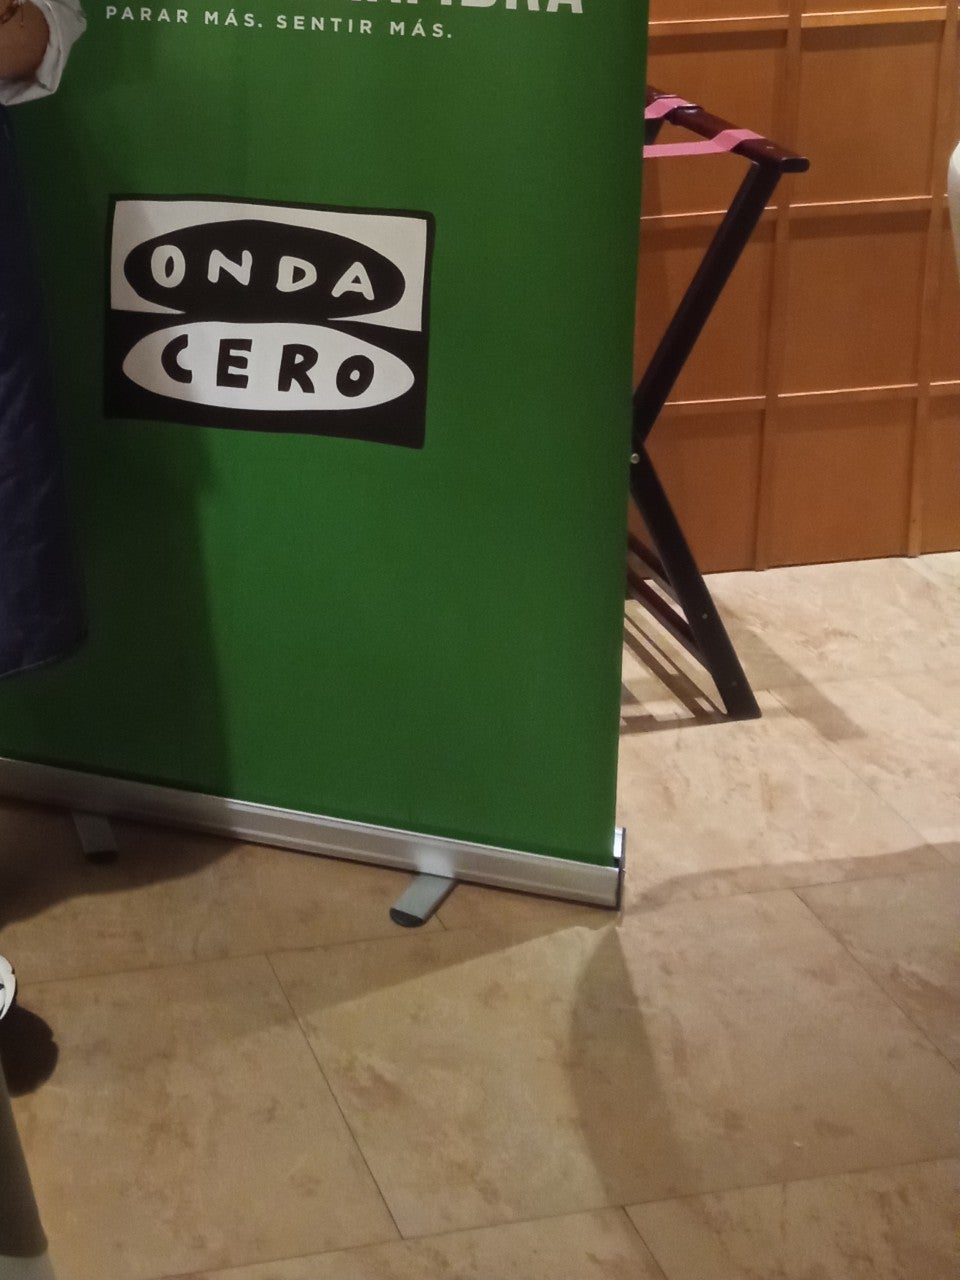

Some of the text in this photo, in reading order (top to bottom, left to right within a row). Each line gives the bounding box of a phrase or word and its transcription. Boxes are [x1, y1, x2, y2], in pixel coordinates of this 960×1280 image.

[106, 6, 452, 39] PARAR MÁS. SENTIR MÁS.
[150, 244, 375, 301] ONDA
[161, 334, 375, 398] CERO
